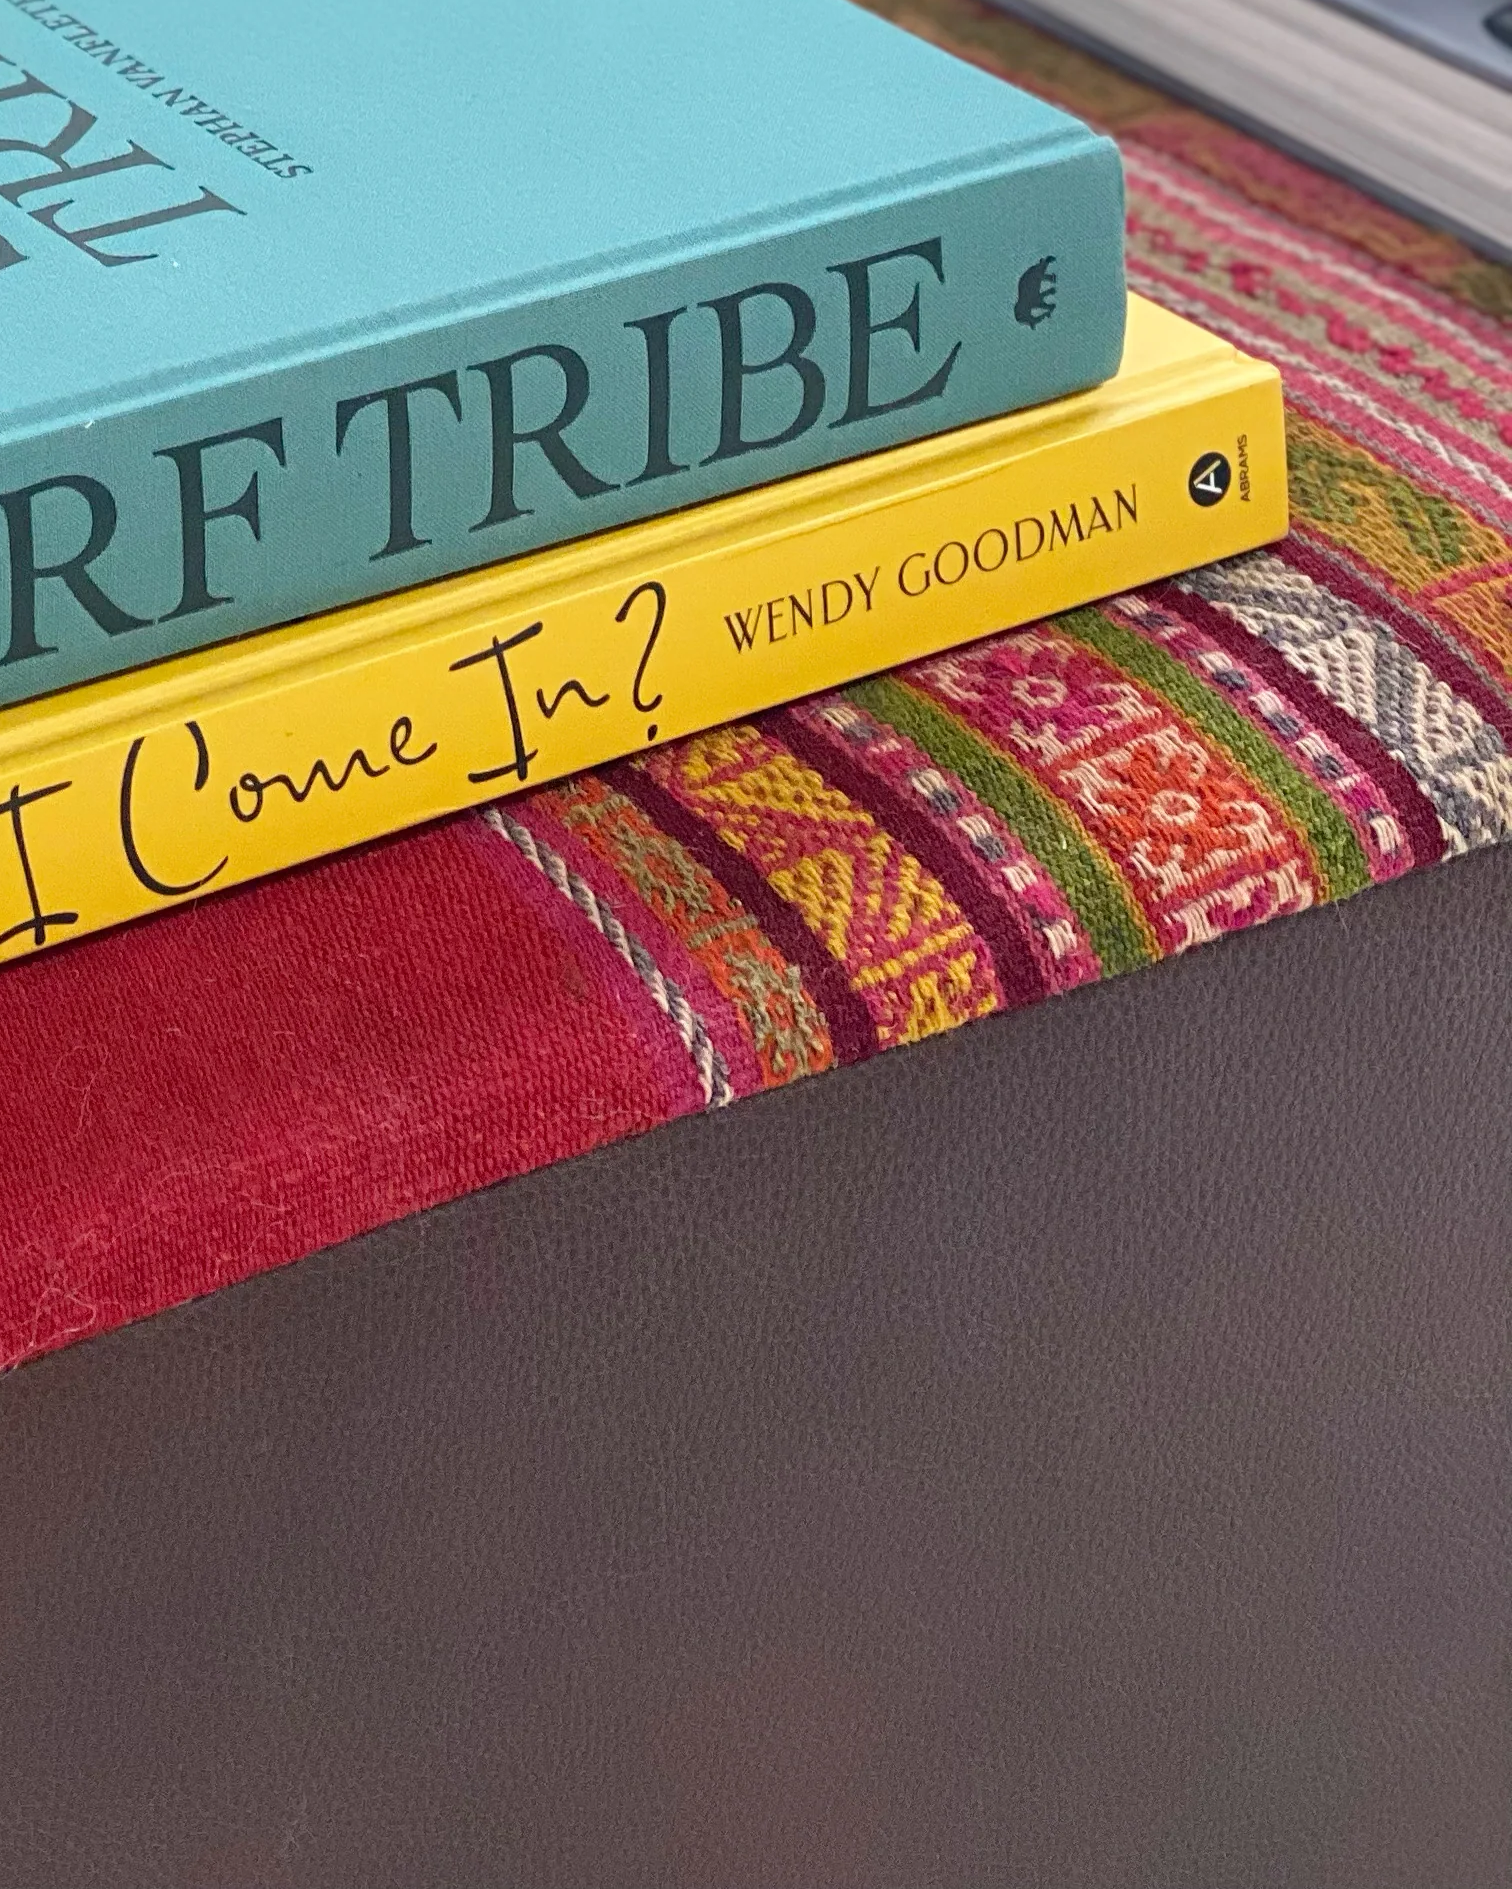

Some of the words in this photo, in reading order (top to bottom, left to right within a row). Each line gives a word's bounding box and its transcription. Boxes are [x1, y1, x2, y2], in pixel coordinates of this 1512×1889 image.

[151, 86, 315, 180] STEPHAN
[335, 236, 963, 563] TRIBE
[1236, 433, 1252, 503] ABRAMS
[724, 567, 882, 655] WENDY
[898, 483, 1141, 598] GOODMAN
[120, 715, 438, 897] Come
[449, 580, 668, 783] In?
